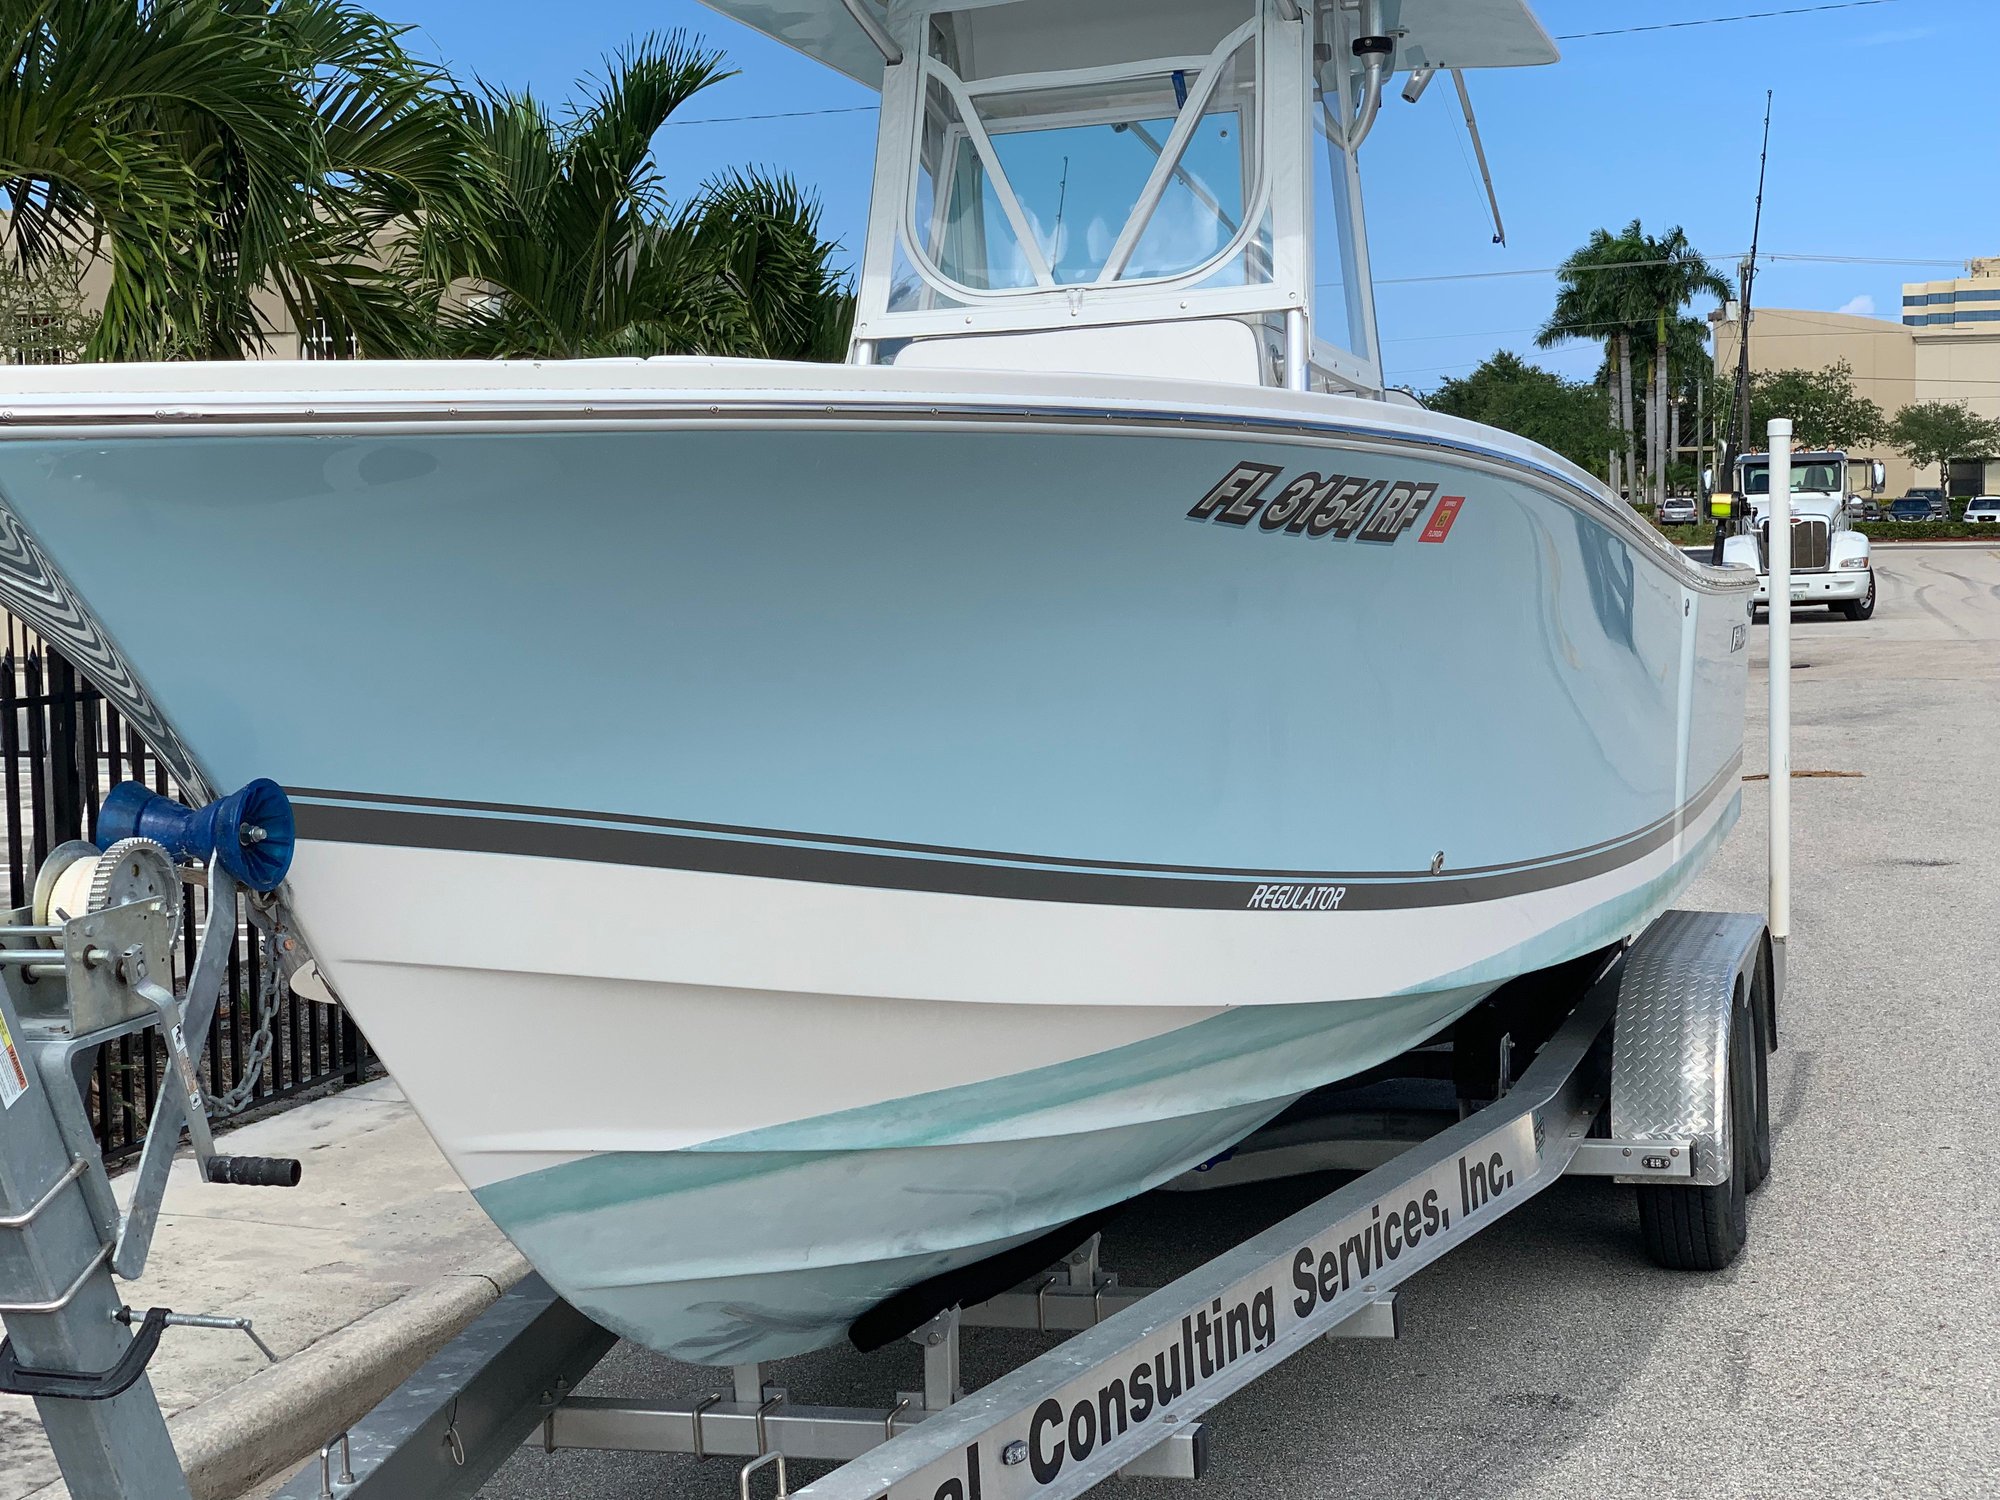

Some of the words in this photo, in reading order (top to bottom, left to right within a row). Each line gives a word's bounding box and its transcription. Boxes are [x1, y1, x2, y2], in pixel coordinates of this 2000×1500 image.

[1189, 462, 1282, 522] FL
[1260, 473, 1386, 536] 3154
[1358, 482, 1437, 540] RF
[1246, 884, 1346, 910] REGULATOR
[8, 1046, 25, 1084] WARNING
[1028, 1285, 1276, 1485] Consulting
[1292, 1204, 1450, 1318] Services,
[1458, 1152, 1514, 1218] Inc.
